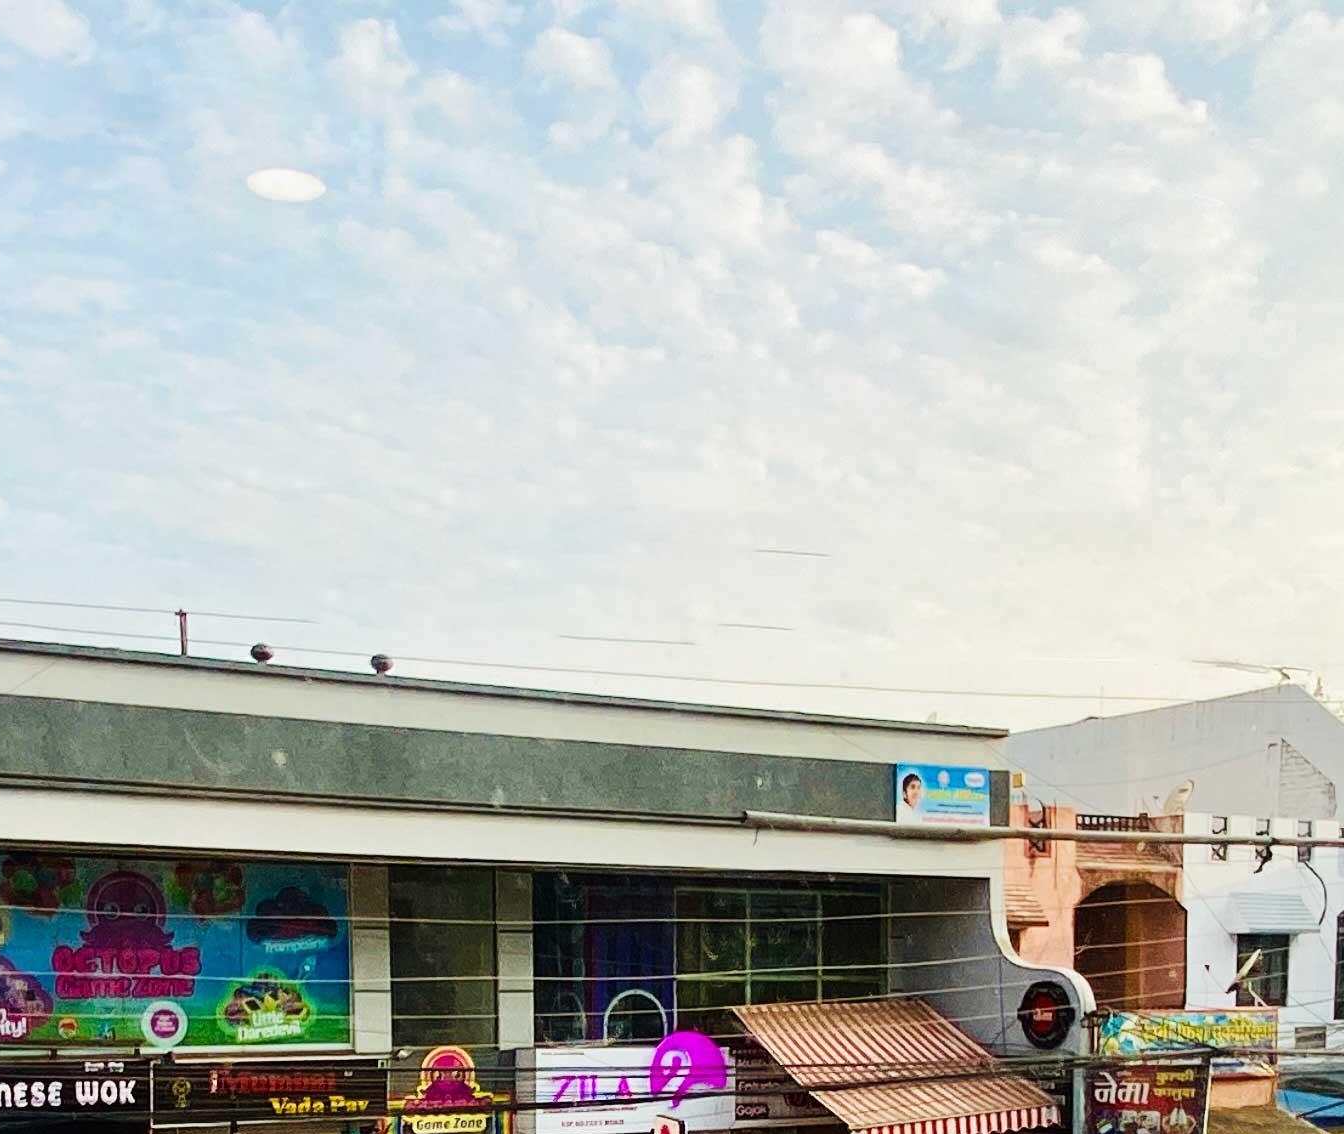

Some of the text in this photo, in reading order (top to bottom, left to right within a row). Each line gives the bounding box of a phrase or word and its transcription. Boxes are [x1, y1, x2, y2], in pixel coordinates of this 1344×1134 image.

[52, 946, 201, 976] OCTOPUS
[252, 1010, 286, 1026] Little
[237, 1022, 301, 1042] Daredevil
[74, 1080, 137, 1106] WOK
[1094, 1071, 1149, 1105] नेमा
[269, 1095, 369, 1114] Vada Pav
[416, 1117, 484, 1132] Game Zone
